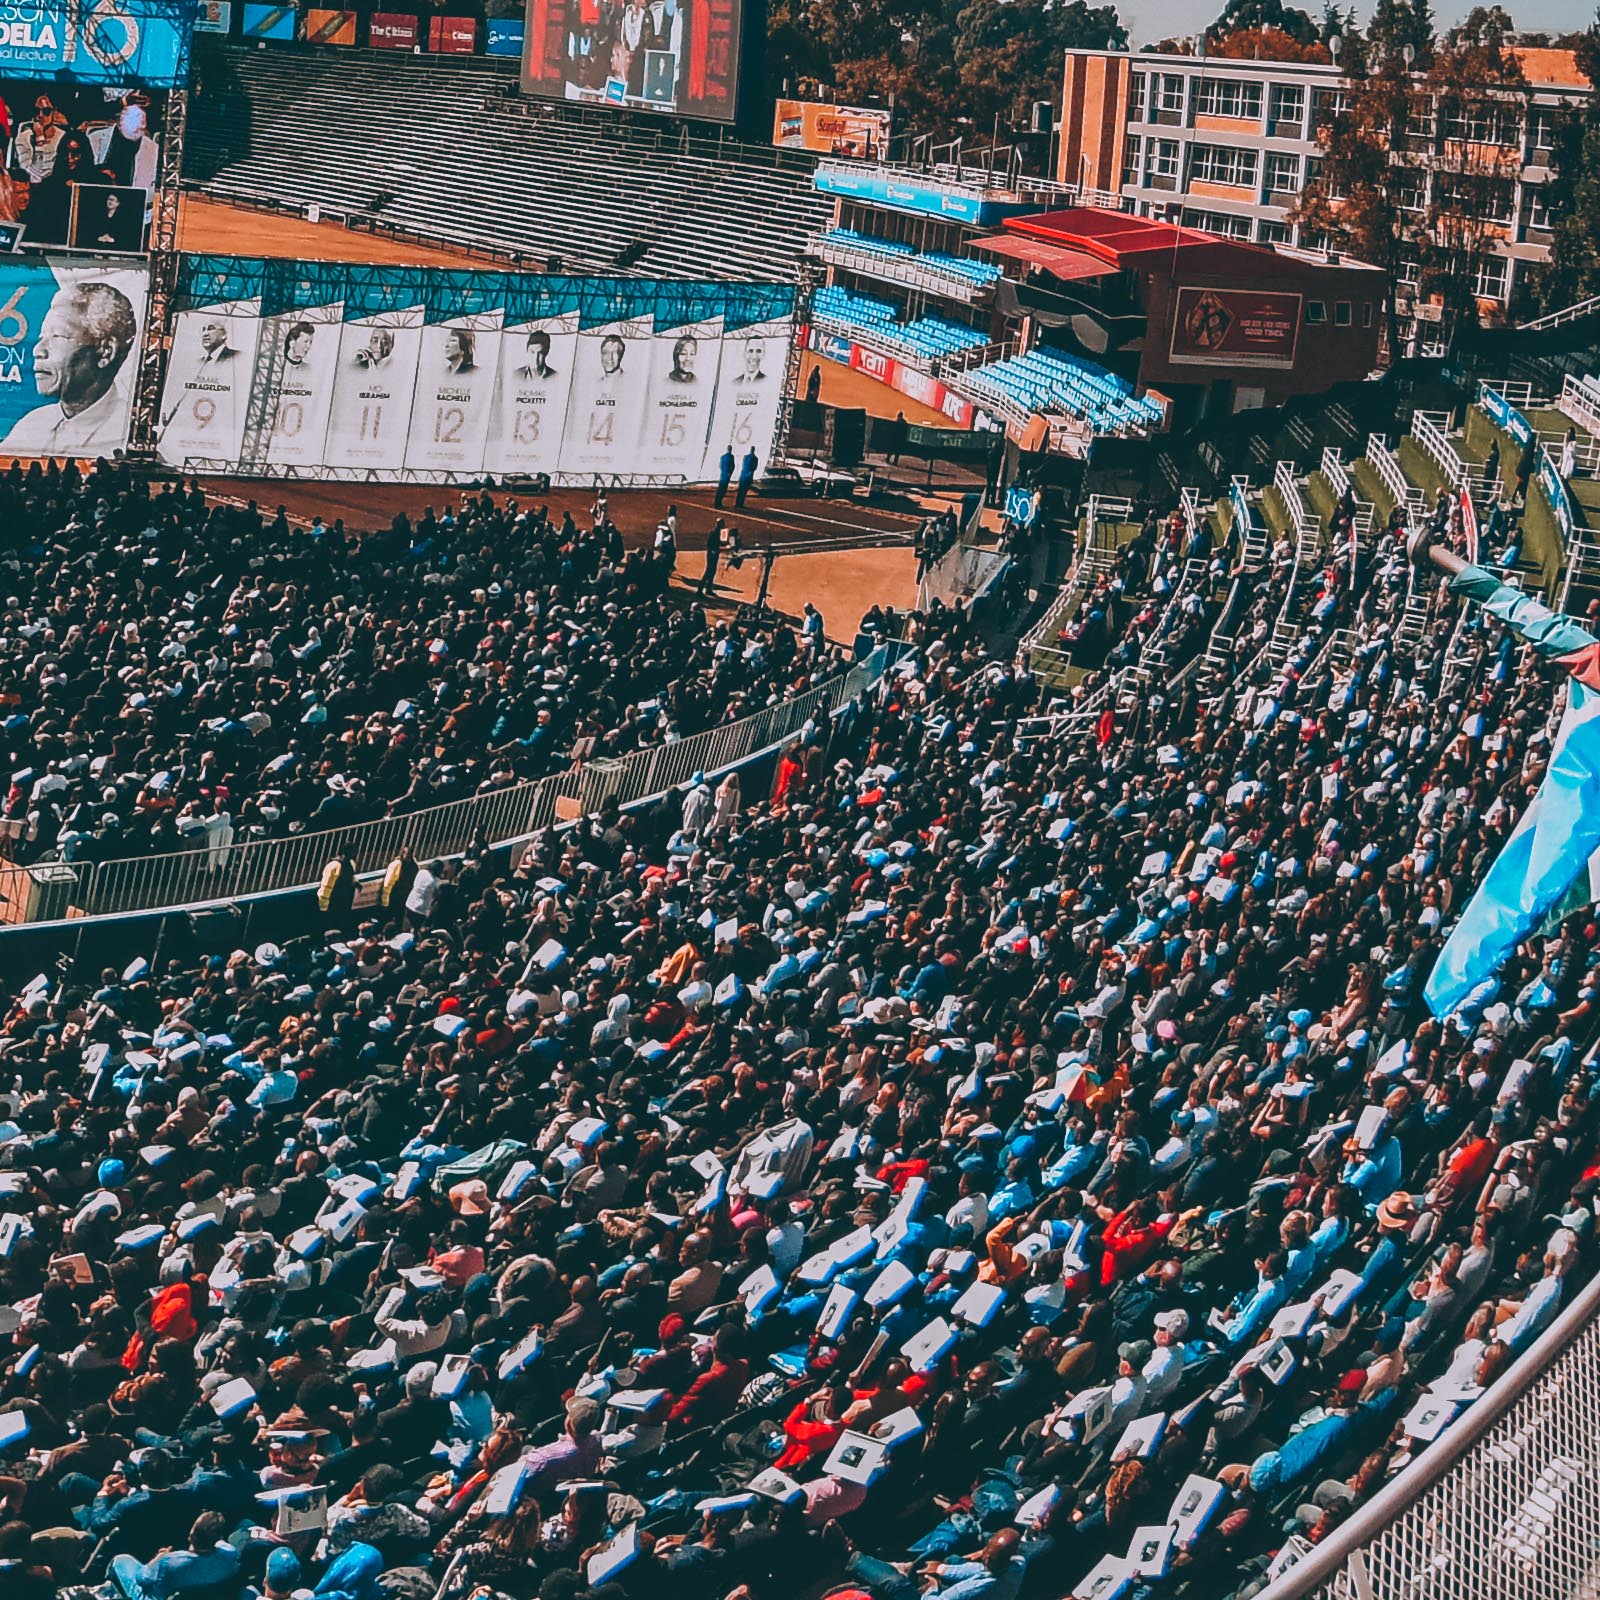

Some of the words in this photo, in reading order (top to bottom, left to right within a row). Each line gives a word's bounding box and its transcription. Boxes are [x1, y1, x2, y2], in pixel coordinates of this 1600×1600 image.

[15, 50, 56, 62] Lecture
[193, 397, 216, 429] 9
[360, 405, 381, 440] 11
[434, 407, 464, 442] 12
[513, 410, 540, 445] 13
[586, 412, 614, 446] 14
[659, 413, 686, 446] 15
[729, 411, 753, 444] 16
